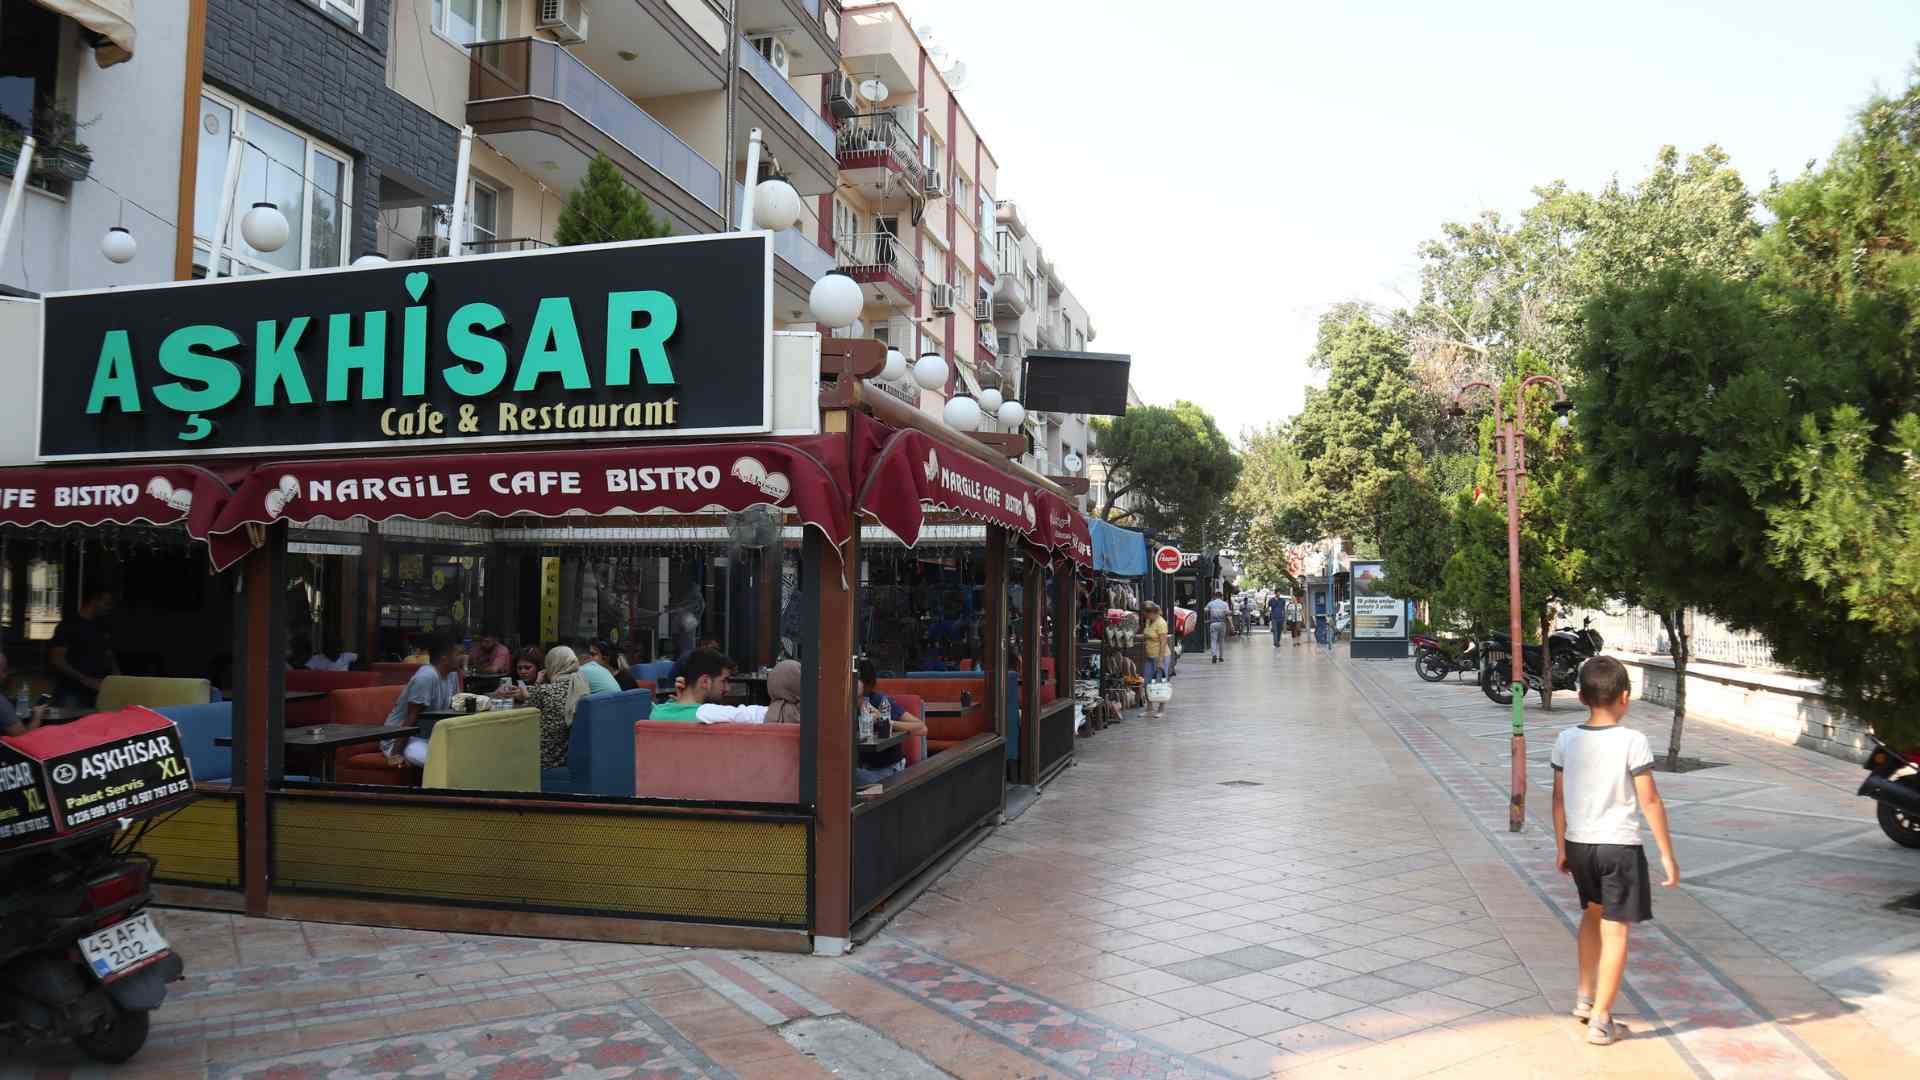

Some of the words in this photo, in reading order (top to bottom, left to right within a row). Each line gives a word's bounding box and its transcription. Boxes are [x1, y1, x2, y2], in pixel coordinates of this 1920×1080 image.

[86, 272, 678, 441] AŞKHİSAR
[380, 402, 444, 436] Cafe
[458, 403, 479, 433] &
[499, 397, 680, 432] Restaurant
[489, 471, 583, 496] CAFE
[606, 465, 721, 493] BISTRO
[0, 488, 36, 510] FE
[54, 483, 140, 508] BISTRO
[81, 735, 174, 780] AŞKHİSAR
[157, 757, 187, 780] XL
[65, 790, 105, 809] Paket
[105, 779, 145, 797] Servis
[89, 933, 113, 953] 45
[116, 917, 150, 944] AFY
[109, 940, 148, 966] 202
